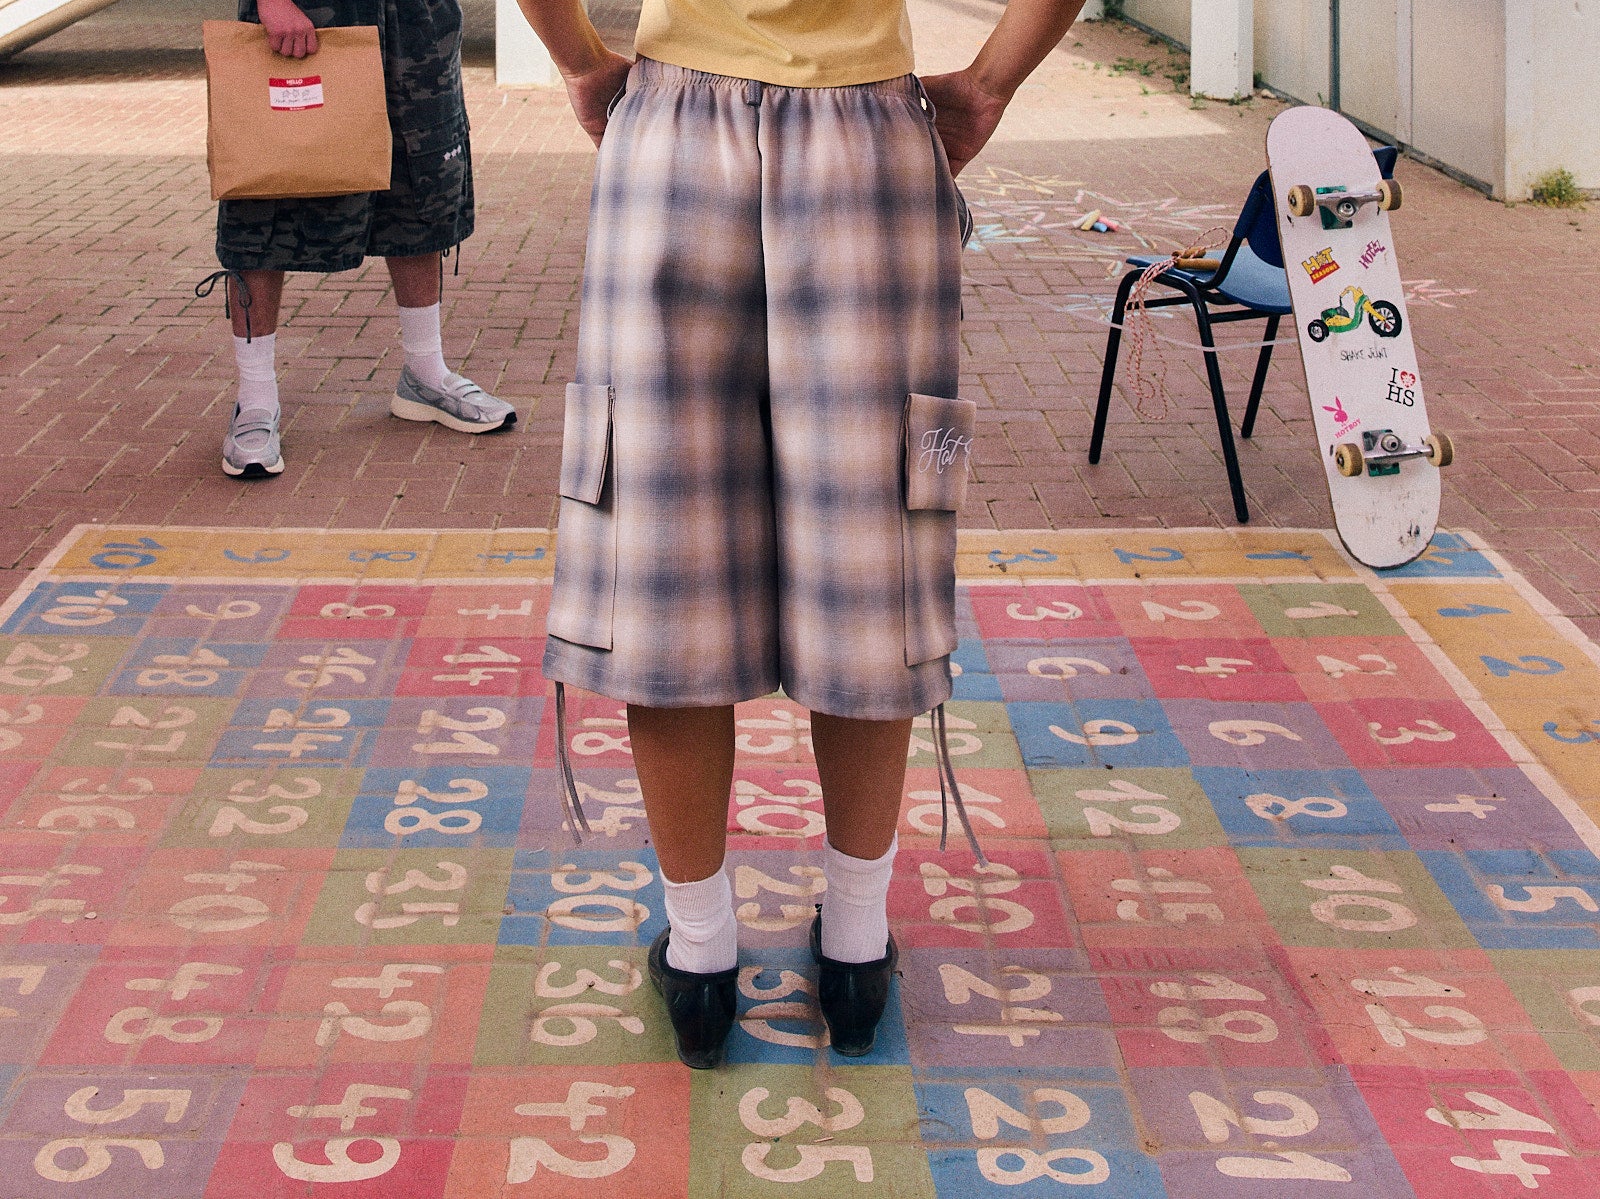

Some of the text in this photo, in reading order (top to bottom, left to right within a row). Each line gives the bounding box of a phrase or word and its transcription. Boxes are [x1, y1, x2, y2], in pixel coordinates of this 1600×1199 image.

[1385, 383, 1415, 408] HS
[1389, 367, 1399, 384] I
[918, 427, 964, 474] Hot
[89, 537, 166, 569] 10
[476, 548, 545, 563] 7
[987, 548, 1058, 564] 3
[1113, 547, 1185, 564] 2
[1245, 550, 1312, 560] 1
[40, 589, 128, 626] 10
[185, 600, 261, 619] 9
[320, 603, 396, 618] 8
[458, 599, 533, 620] 7
[1006, 601, 1083, 621] 3
[1141, 600, 1220, 622] 2
[1285, 601, 1358, 619] 1
[1437, 603, 1512, 618] 1
[0, 642, 90, 687] 20
[136, 649, 228, 686] 18
[285, 648, 376, 690] 16
[432, 645, 518, 686] 14
[1027, 656, 1111, 679] 6
[1176, 657, 1253, 678] 4
[1316, 654, 1398, 678] 2
[1480, 655, 1566, 677] 2
[95, 706, 197, 752] 27
[252, 707, 351, 758] 24
[413, 707, 507, 755] 21
[1049, 719, 1139, 745] 9
[1208, 719, 1300, 745] 6
[1368, 719, 1455, 745] 3
[208, 777, 321, 837] 32
[384, 778, 489, 835] 28
[733, 779, 826, 837] 20
[1074, 779, 1182, 837] 12
[1244, 792, 1348, 819] 8
[1425, 794, 1506, 819] 4
[169, 861, 286, 933] 40
[354, 861, 468, 930] 35
[546, 861, 653, 933] 30
[919, 862, 1034, 934] 20
[1303, 865, 1417, 932] 10
[1487, 884, 1599, 913] 5
[103, 961, 243, 1045] 48
[314, 963, 446, 1046] 42
[531, 960, 645, 1047] 36
[938, 963, 1063, 1048] 24
[1149, 972, 1279, 1043] 18
[1351, 966, 1489, 1047] 12
[34, 1086, 193, 1183] 56
[272, 1083, 413, 1183] 49
[506, 1081, 637, 1184] 42
[738, 1087, 874, 1184] 35
[964, 1087, 1110, 1186] 28
[1189, 1090, 1352, 1183] 21
[1425, 1091, 1569, 1190] 14
